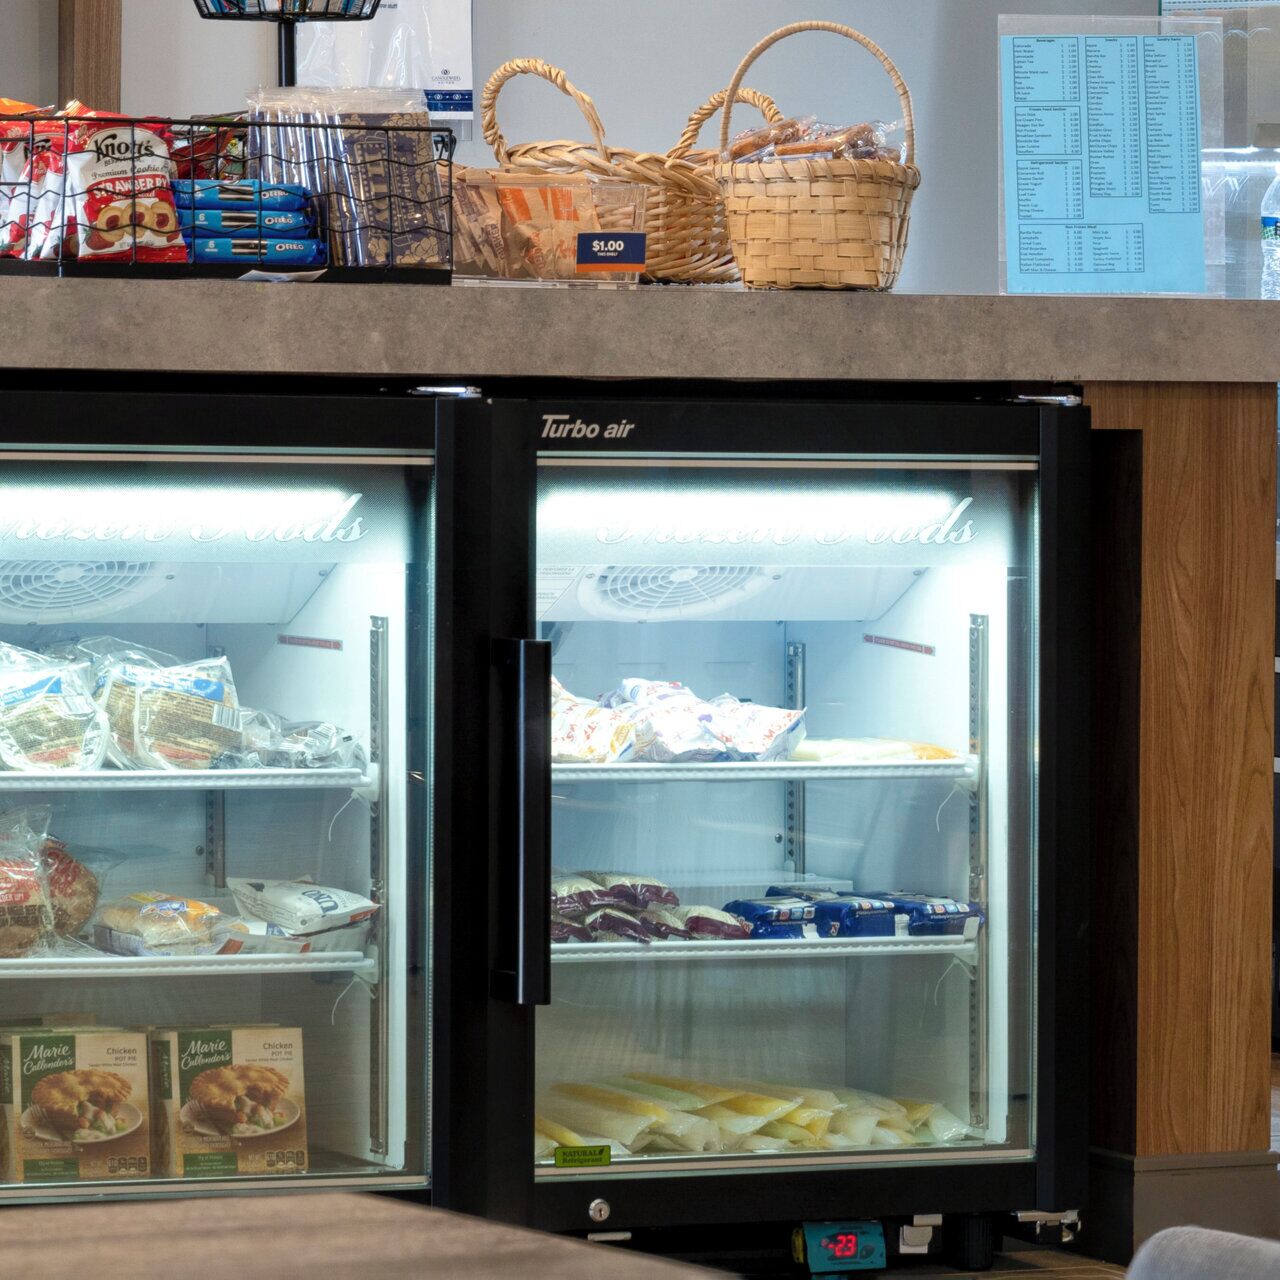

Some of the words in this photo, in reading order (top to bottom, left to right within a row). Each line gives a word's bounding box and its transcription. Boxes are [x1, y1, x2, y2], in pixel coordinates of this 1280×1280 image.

[94, 177, 168, 198] STRAWBERRY
[264, 216, 293, 225] OREO
[275, 243, 304, 252] OREO
[592, 240, 625, 252] $1.00
[541, 414, 600, 438] Turbo
[604, 419, 635, 438] air
[25, 1044, 71, 1059] Marie
[107, 1047, 137, 1056] Chicken
[182, 1039, 228, 1054] Marie
[262, 1041, 293, 1050] Chicken
[828, 1234, 857, 1257] -23
